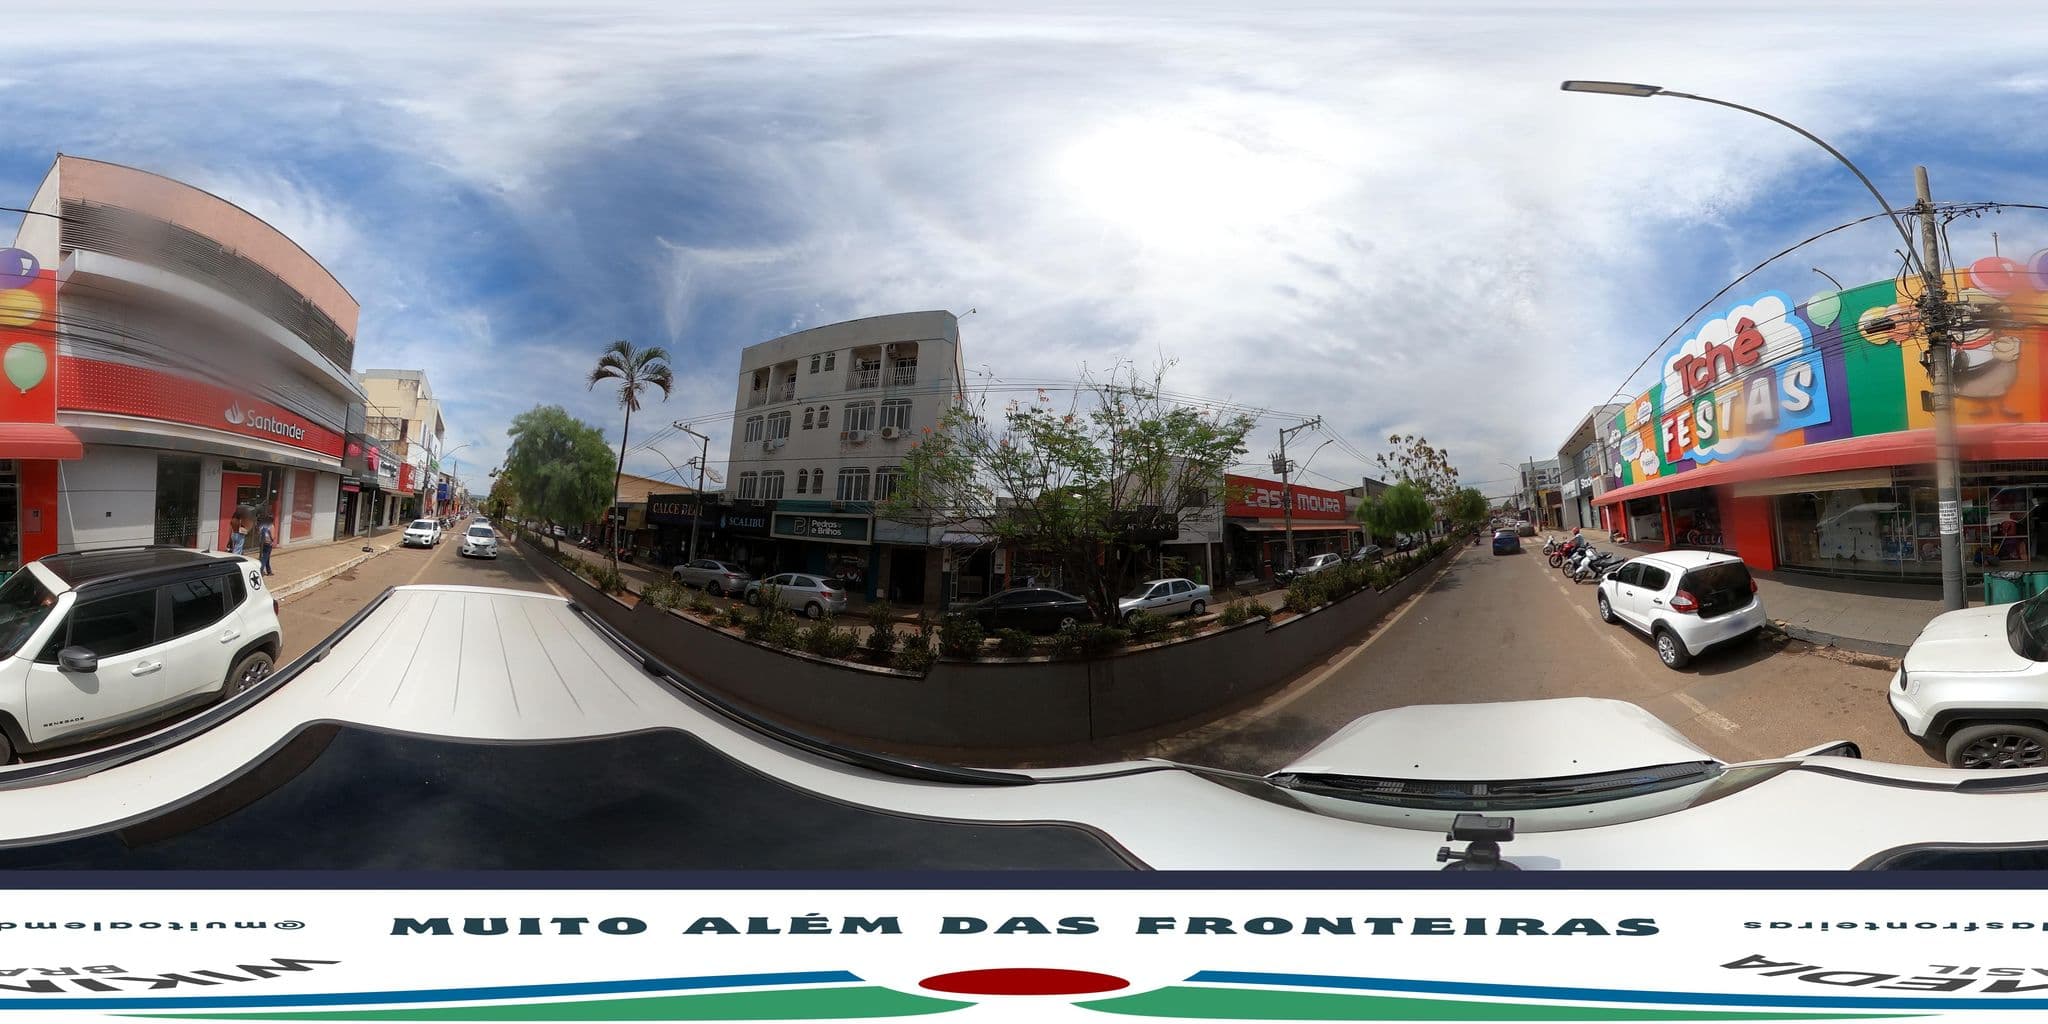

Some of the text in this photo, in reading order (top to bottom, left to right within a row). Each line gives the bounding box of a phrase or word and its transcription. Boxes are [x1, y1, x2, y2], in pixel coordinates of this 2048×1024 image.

[1673, 317, 1764, 397] Tchê
[1661, 361, 1813, 454] FESTAS
[246, 409, 305, 440] Santander
[811, 519, 838, 529] Pedras
[817, 527, 842, 537] Brilhos
